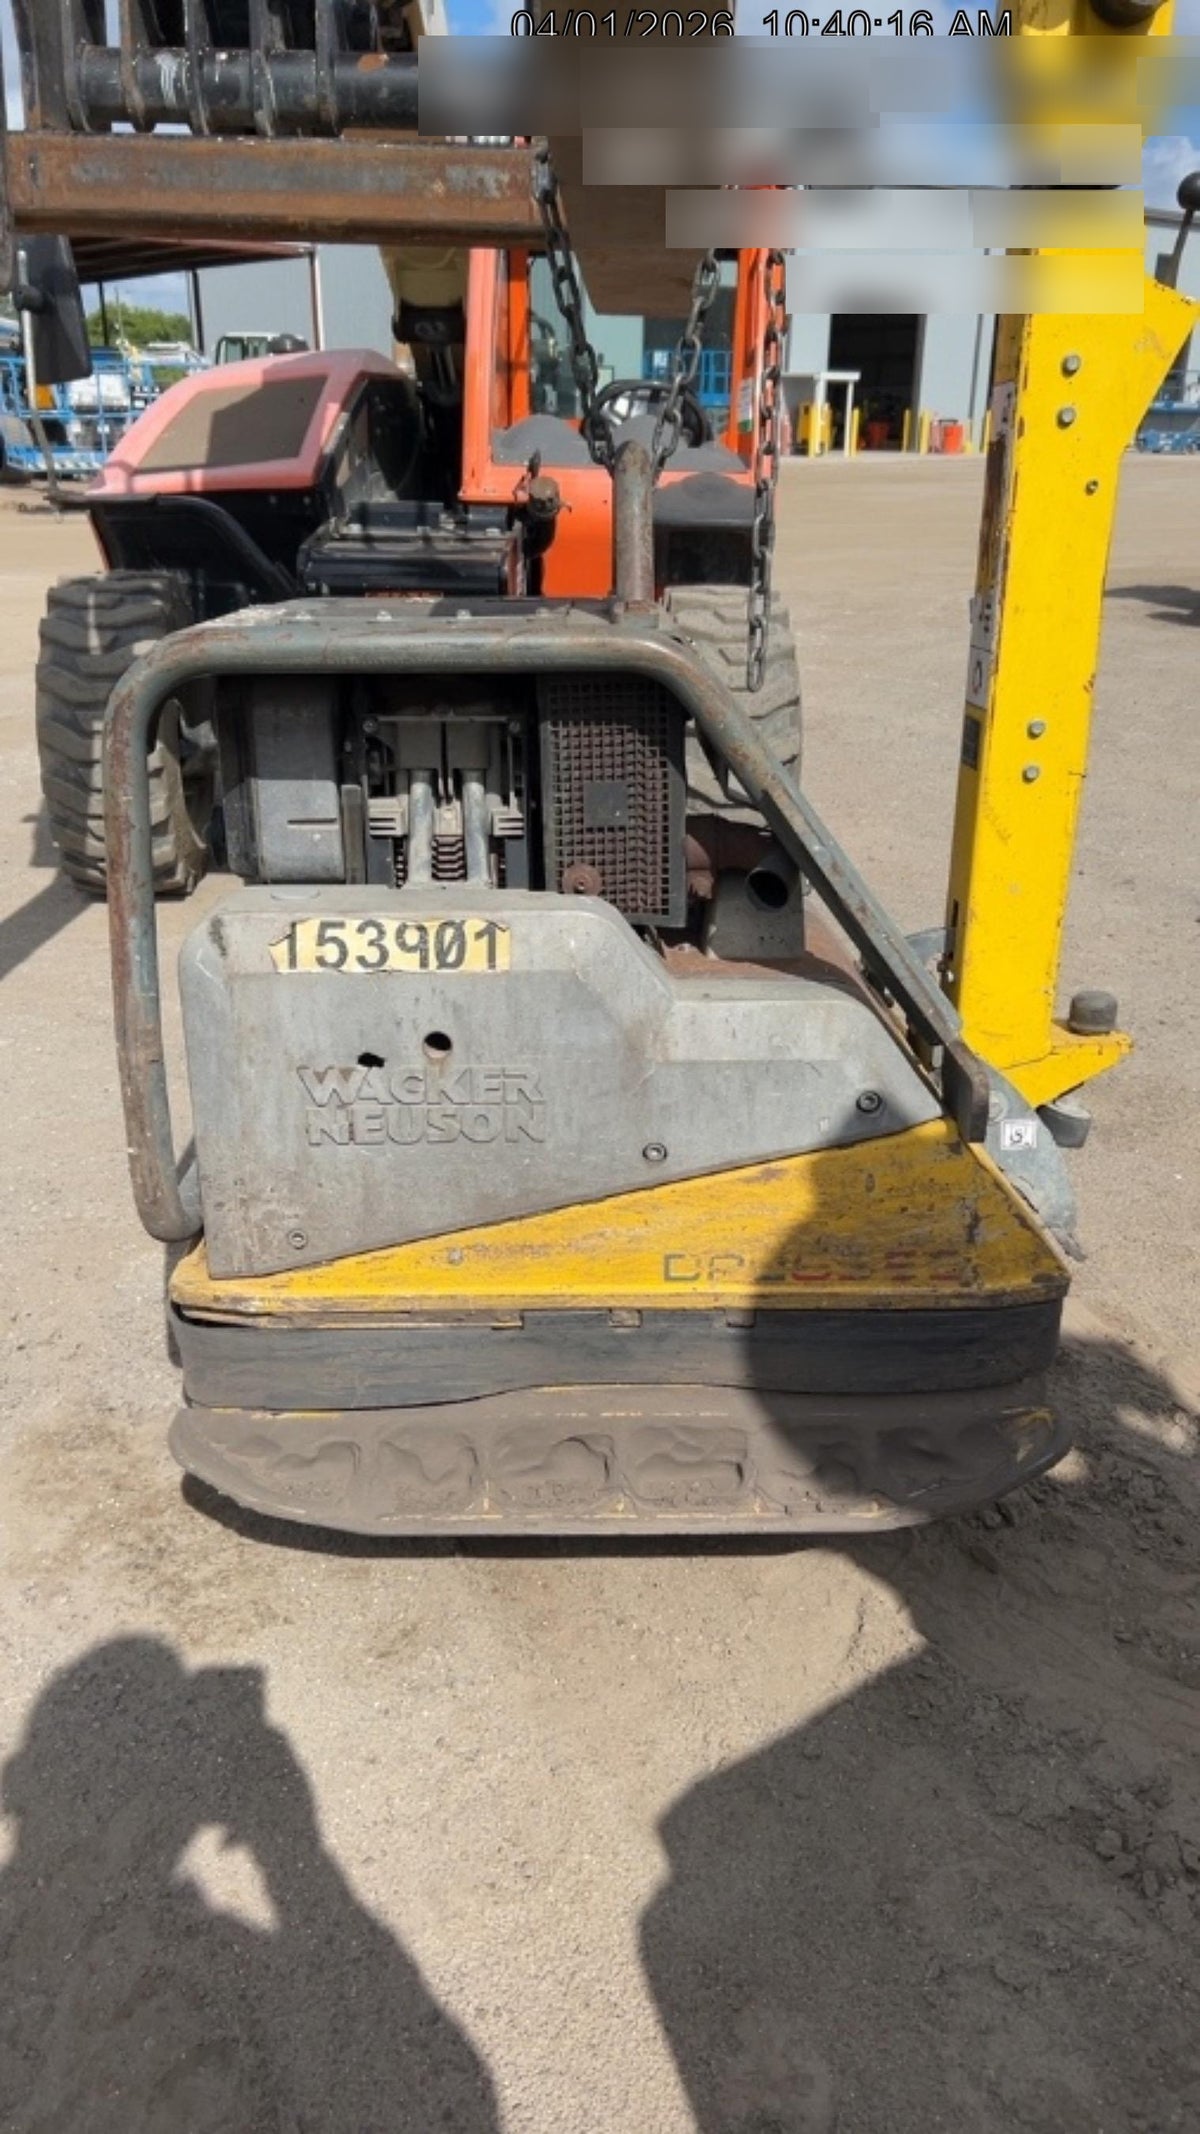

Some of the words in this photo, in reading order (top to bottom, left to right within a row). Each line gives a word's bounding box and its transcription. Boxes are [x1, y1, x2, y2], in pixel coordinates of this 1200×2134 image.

[284, 919, 499, 971] 153901
[296, 1064, 546, 1107] WACKER
[306, 1105, 546, 1146] NEUSON
